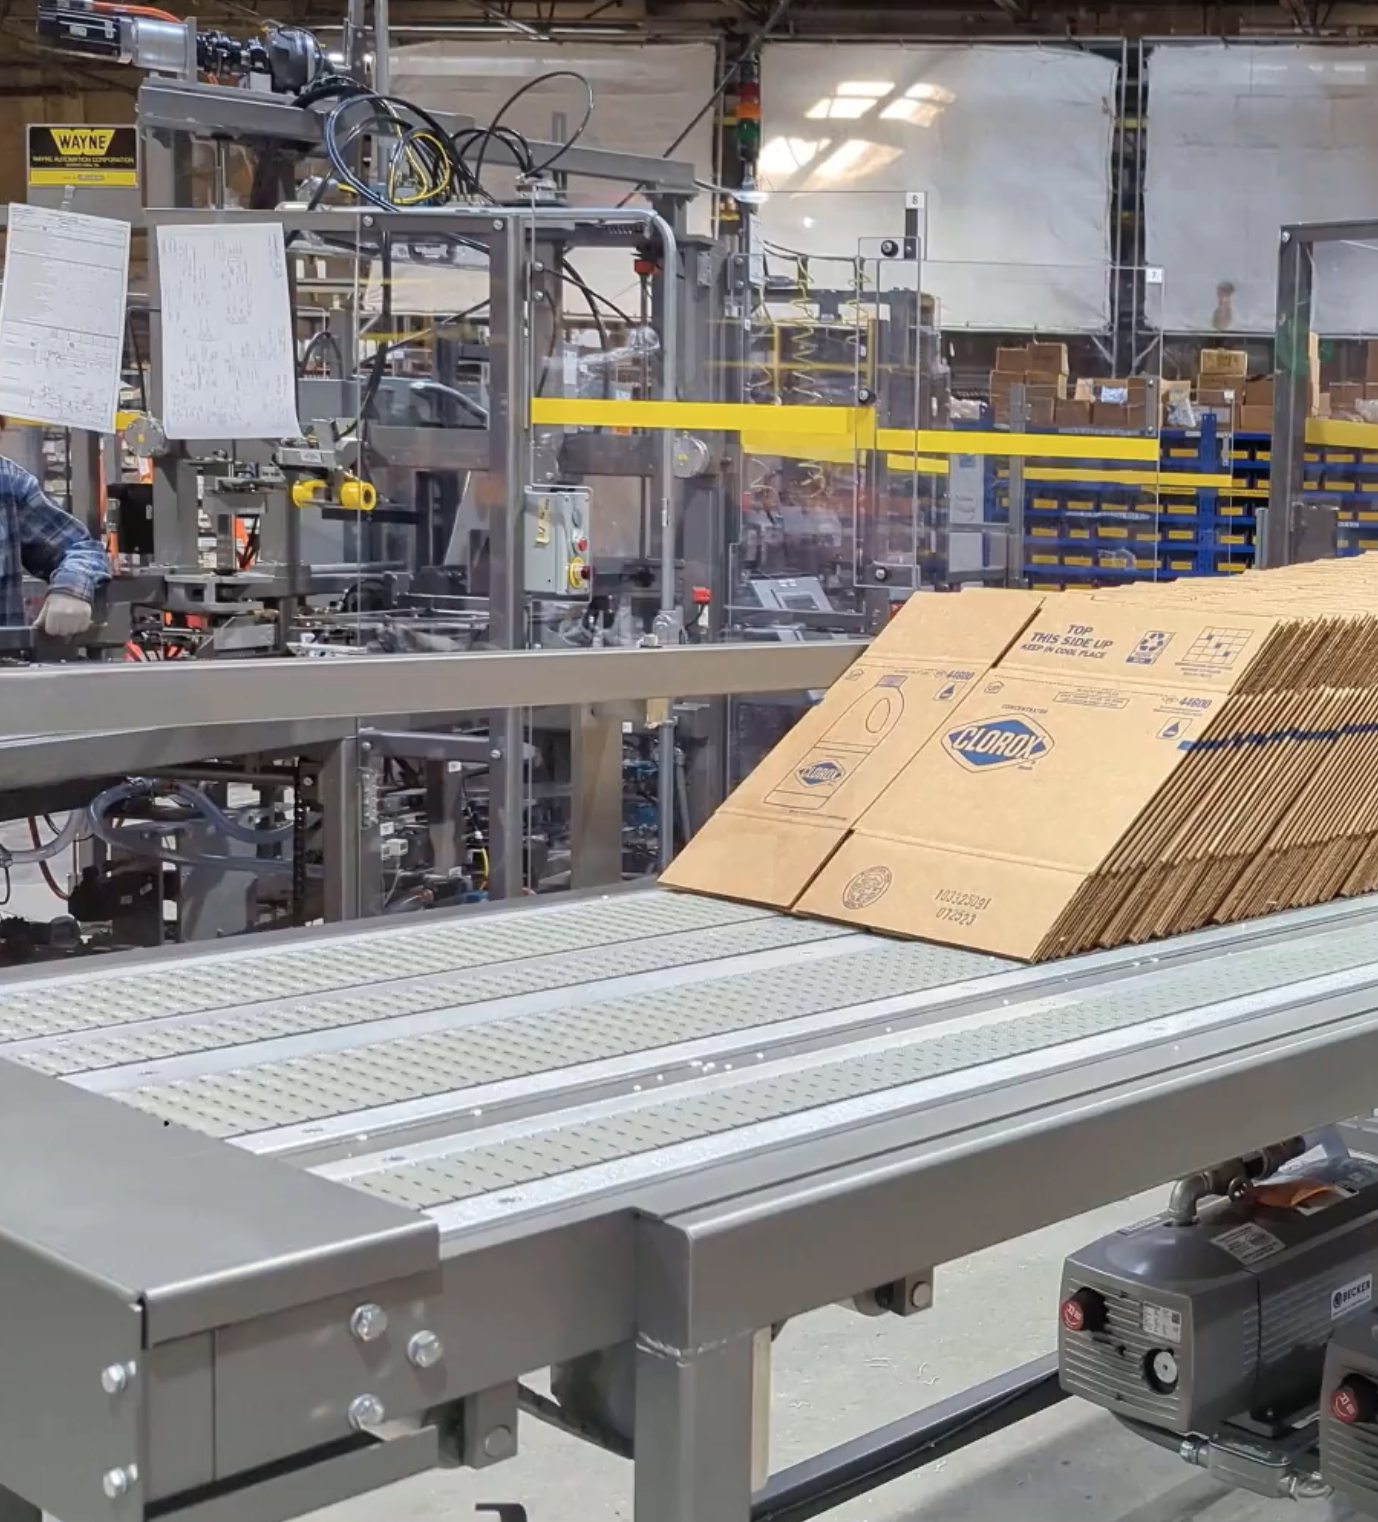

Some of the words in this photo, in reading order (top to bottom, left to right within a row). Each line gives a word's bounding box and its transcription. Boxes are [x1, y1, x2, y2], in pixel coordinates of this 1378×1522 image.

[58, 135, 107, 150] WAYNE
[1067, 624, 1093, 635] TOP
[1030, 632, 1060, 645] THIS
[1061, 636, 1094, 649] SIDE
[1095, 639, 1114, 650] UP
[1055, 648, 1076, 656] COOL
[1078, 650, 1107, 659] PLACE
[952, 726, 1043, 760] CLOROX
[802, 765, 841, 781] CLOROX
[1343, 1279, 1370, 1303] BECKER
